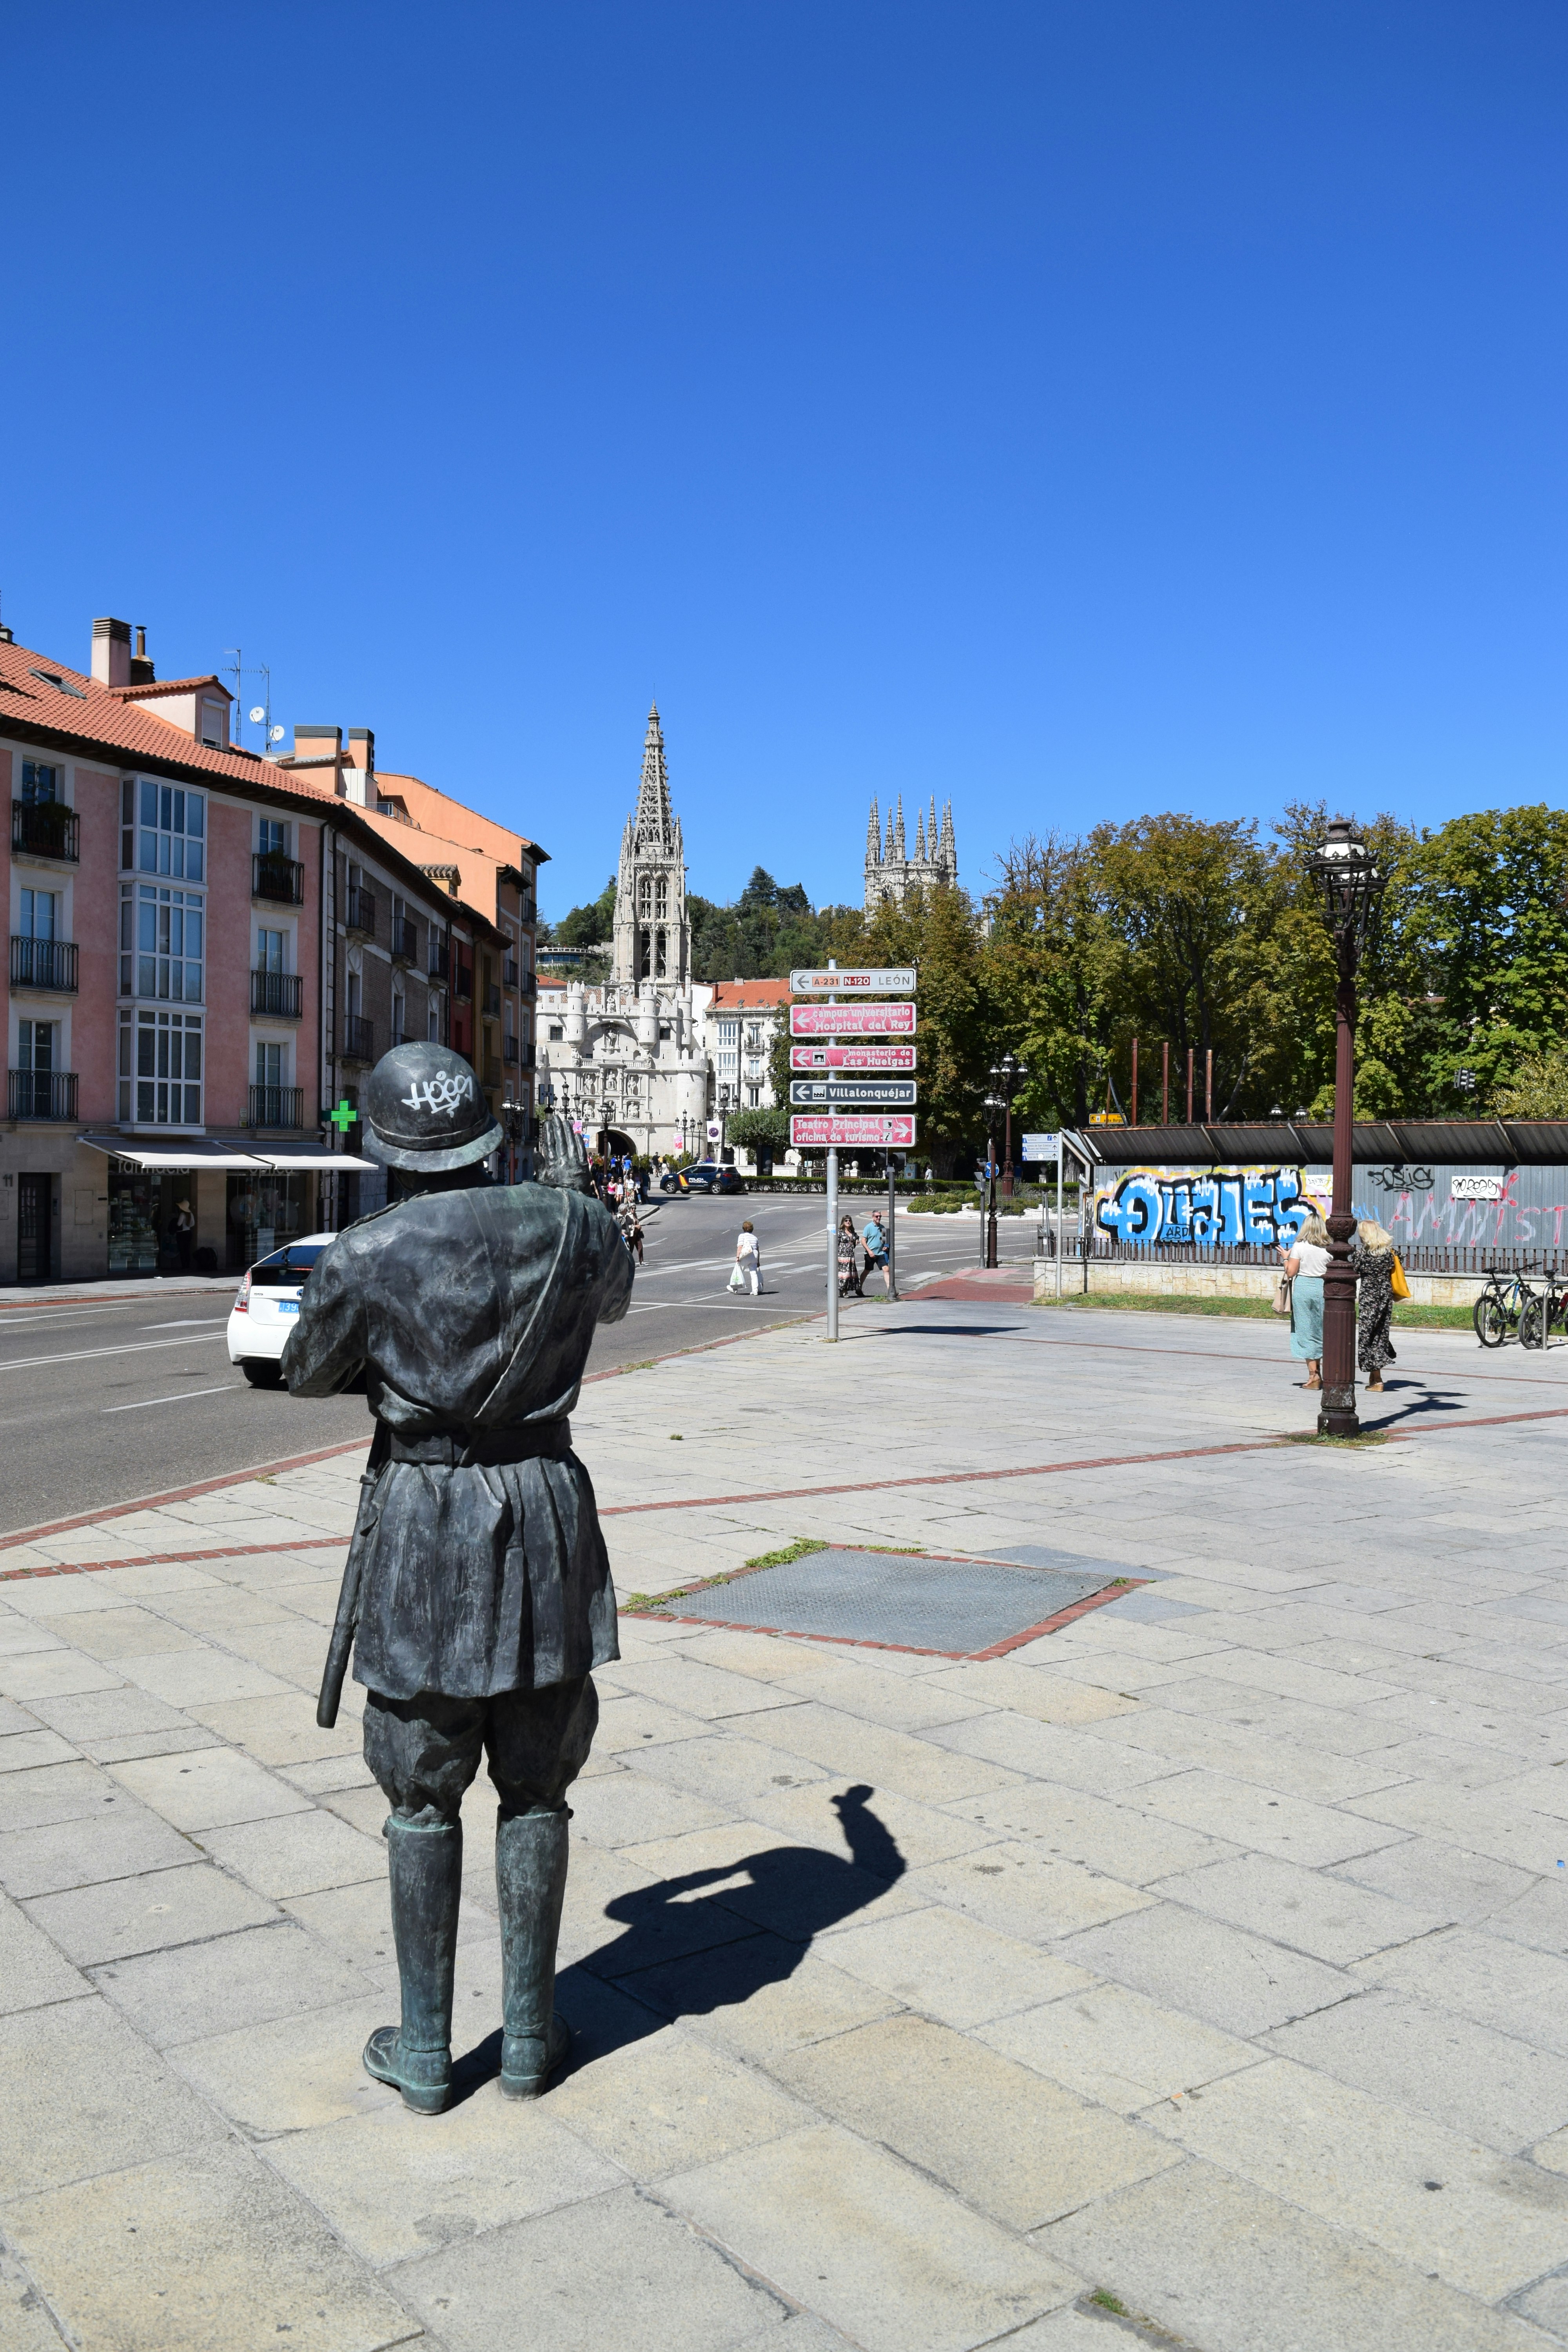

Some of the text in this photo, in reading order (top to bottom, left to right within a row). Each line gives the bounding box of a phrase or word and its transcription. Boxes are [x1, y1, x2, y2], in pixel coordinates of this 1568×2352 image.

[879, 975, 910, 985] LEÓN
[813, 1008, 910, 1018] campus universitario
[816, 1020, 910, 1032] Hospital del Rey
[844, 1057, 910, 1067] Las Huelgas
[829, 1088, 911, 1099] Villalonquéjar
[796, 1120, 878, 1129] Teatro Principal
[796, 1132, 880, 1142] oficina de turismo
[285, 1303, 299, 1312] 39
